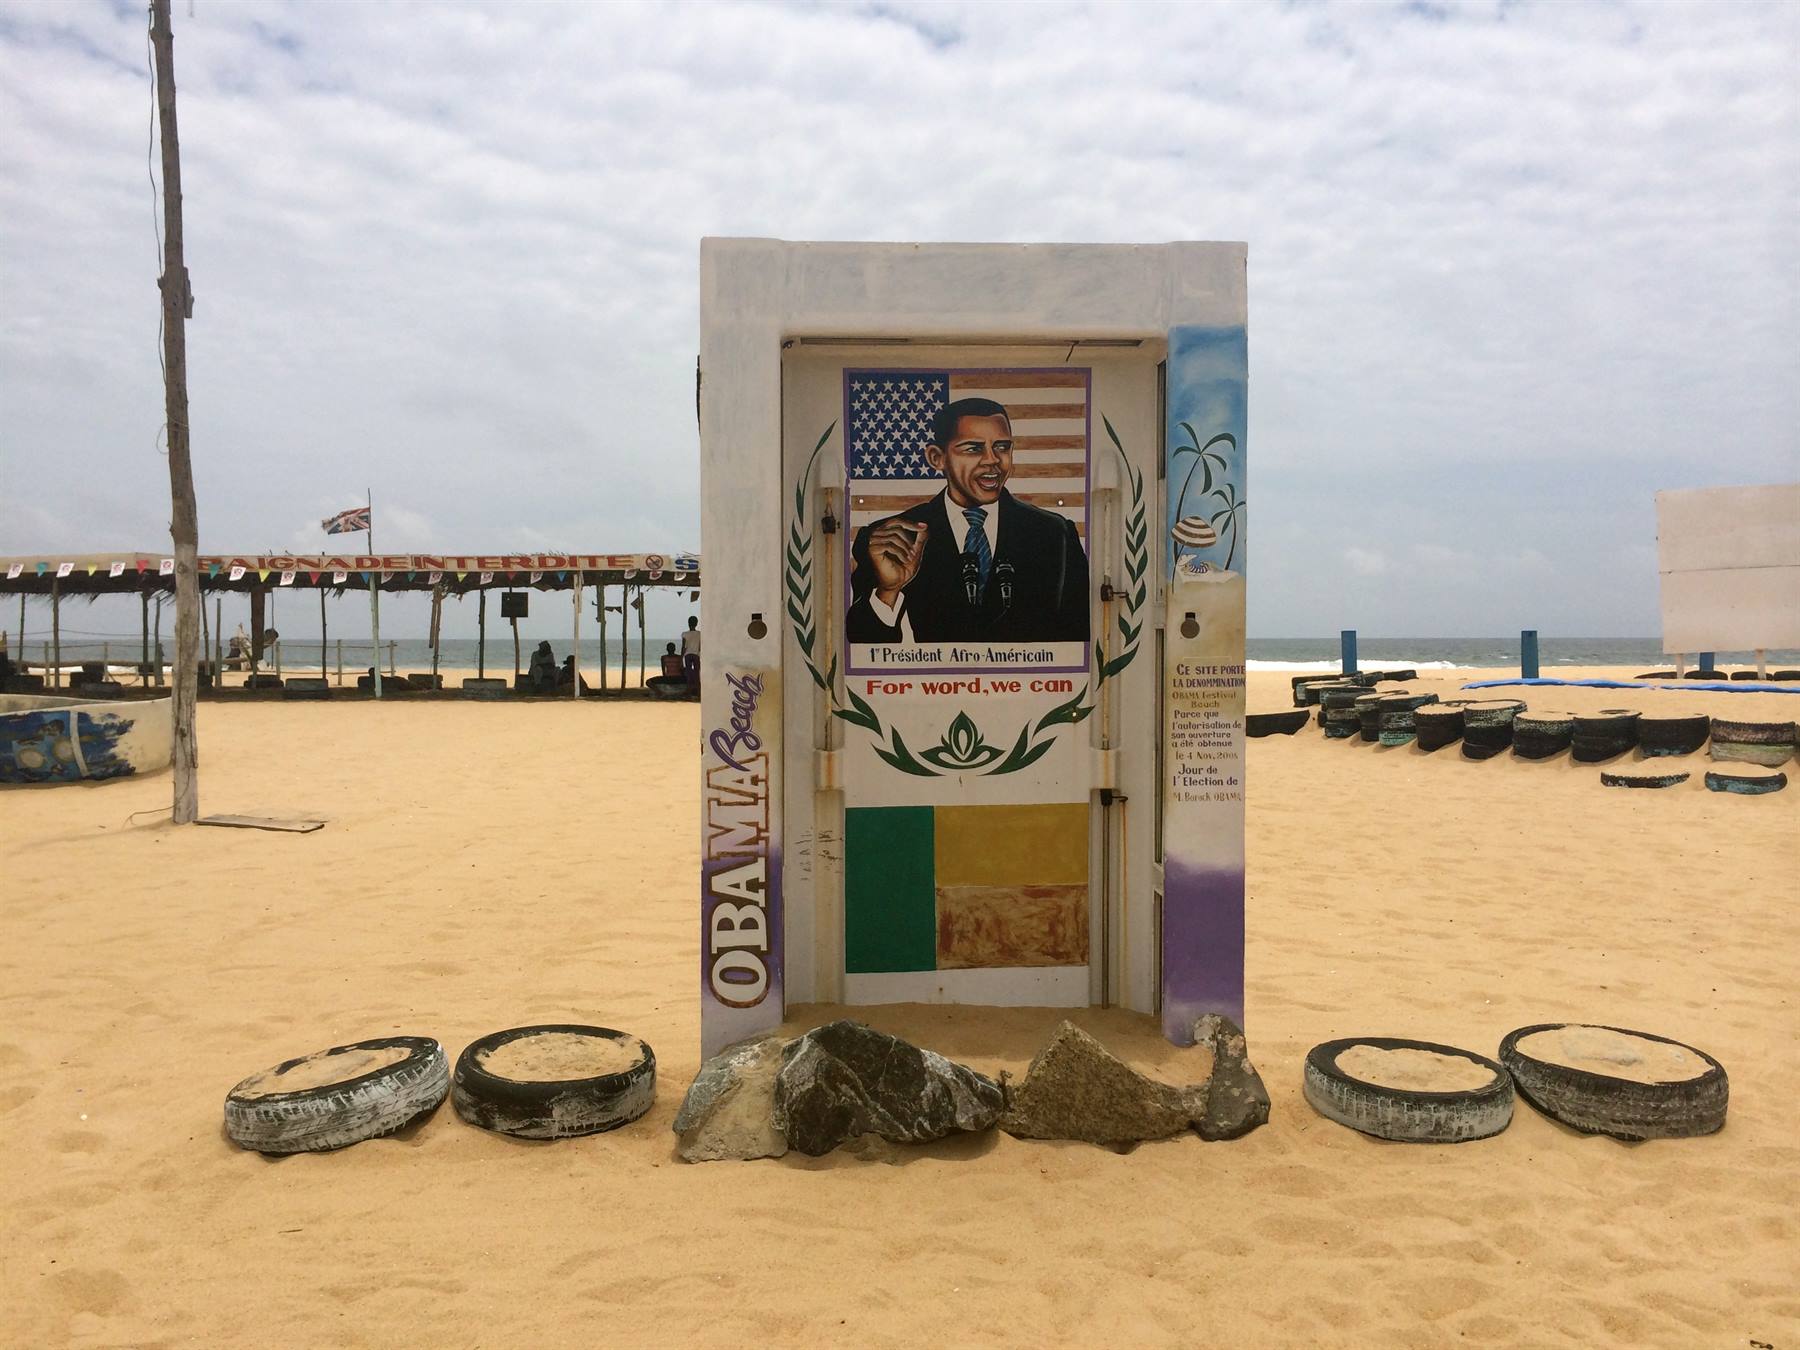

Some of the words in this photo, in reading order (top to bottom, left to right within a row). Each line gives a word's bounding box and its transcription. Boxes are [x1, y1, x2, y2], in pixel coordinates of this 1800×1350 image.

[412, 555, 634, 570] INTERDITE
[882, 647, 943, 663] Président
[950, 647, 1054, 663] Afro-Américain
[1220, 664, 1246, 675] PORTE
[866, 679, 913, 695] For
[920, 677, 989, 697] word,
[990, 679, 1022, 694] we
[1029, 679, 1073, 694] can
[1172, 678, 1184, 688] LA
[1174, 709, 1201, 719] Parce
[1203, 711, 1219, 720] que
[709, 671, 764, 772] Beach
[1232, 720, 1242, 729] de
[1171, 732, 1186, 740] son
[1188, 730, 1231, 739] ouverture
[1197, 739, 1233, 748] obtenue
[1175, 750, 1185, 760] le
[1178, 763, 1204, 775] Jour
[1206, 765, 1218, 775] de
[1226, 776, 1239, 786] de
[706, 752, 769, 1009] OBAMA
